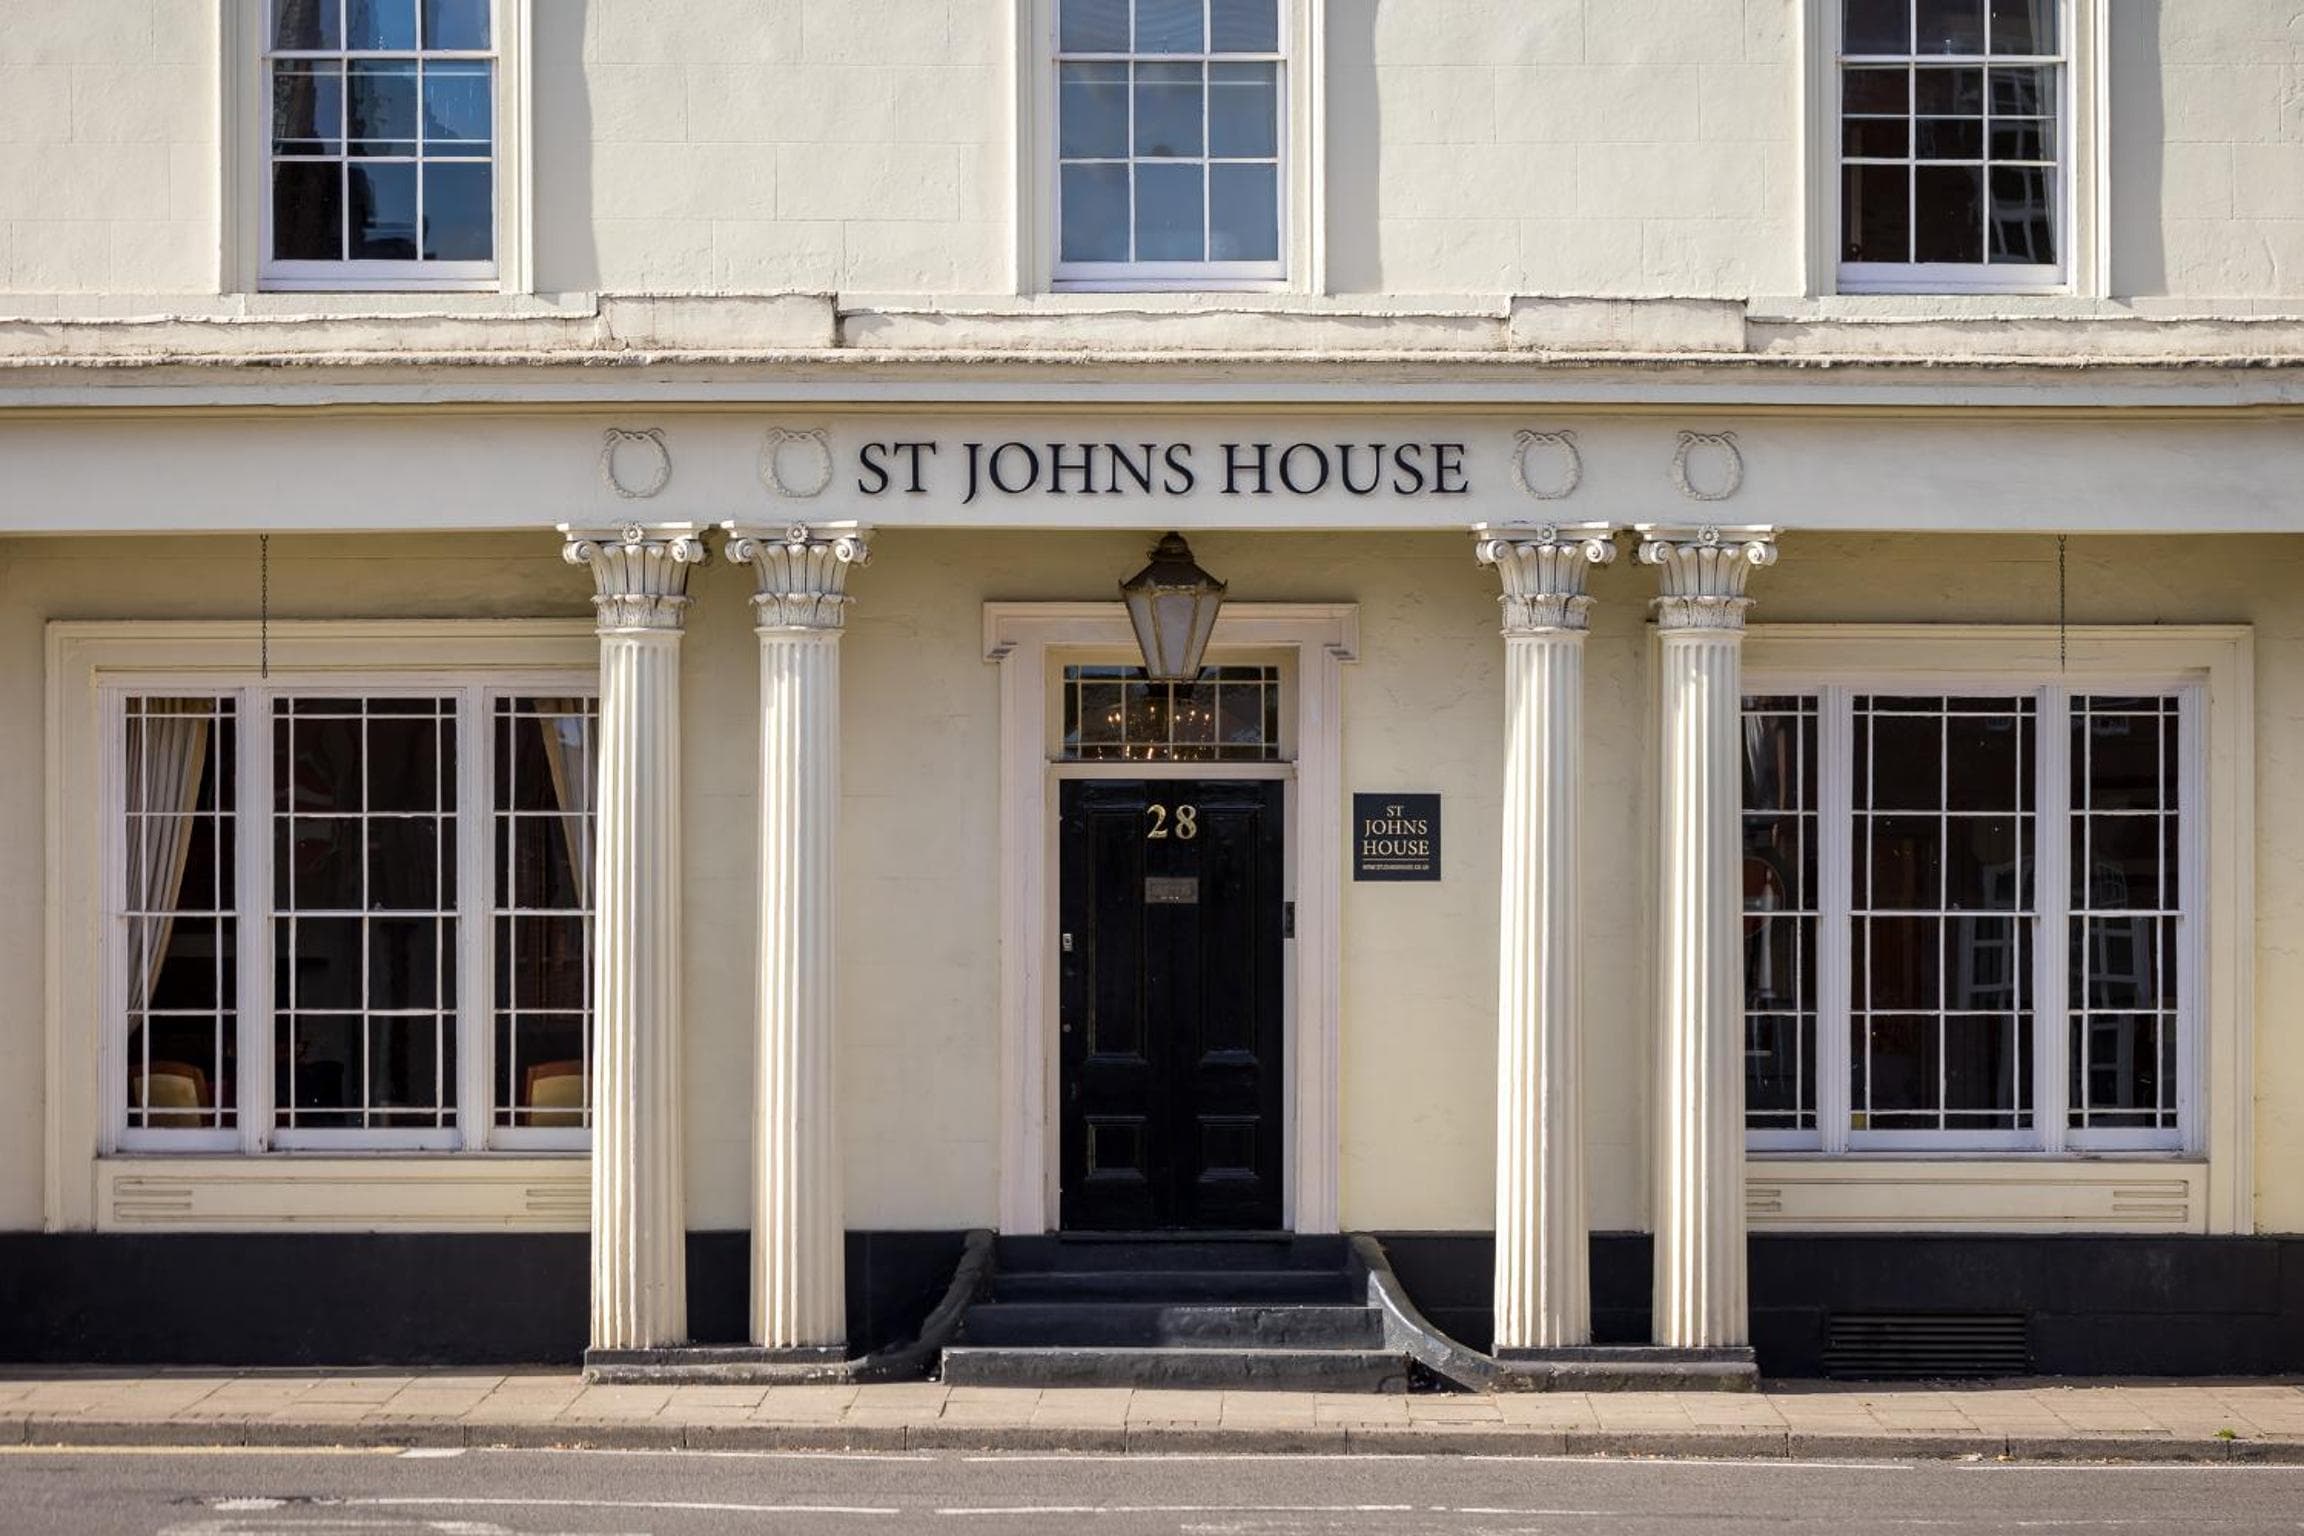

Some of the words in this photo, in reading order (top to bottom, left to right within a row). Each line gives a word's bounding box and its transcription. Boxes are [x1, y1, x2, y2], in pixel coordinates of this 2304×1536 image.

[857, 442, 936, 495] ST
[962, 442, 1195, 504] JOHNS
[1220, 442, 1470, 495] HOUSE
[1386, 805, 1404, 817] ST
[1147, 804, 1197, 839] 28
[1364, 819, 1428, 838] JOHNS
[1363, 839, 1430, 855] HOUSE
